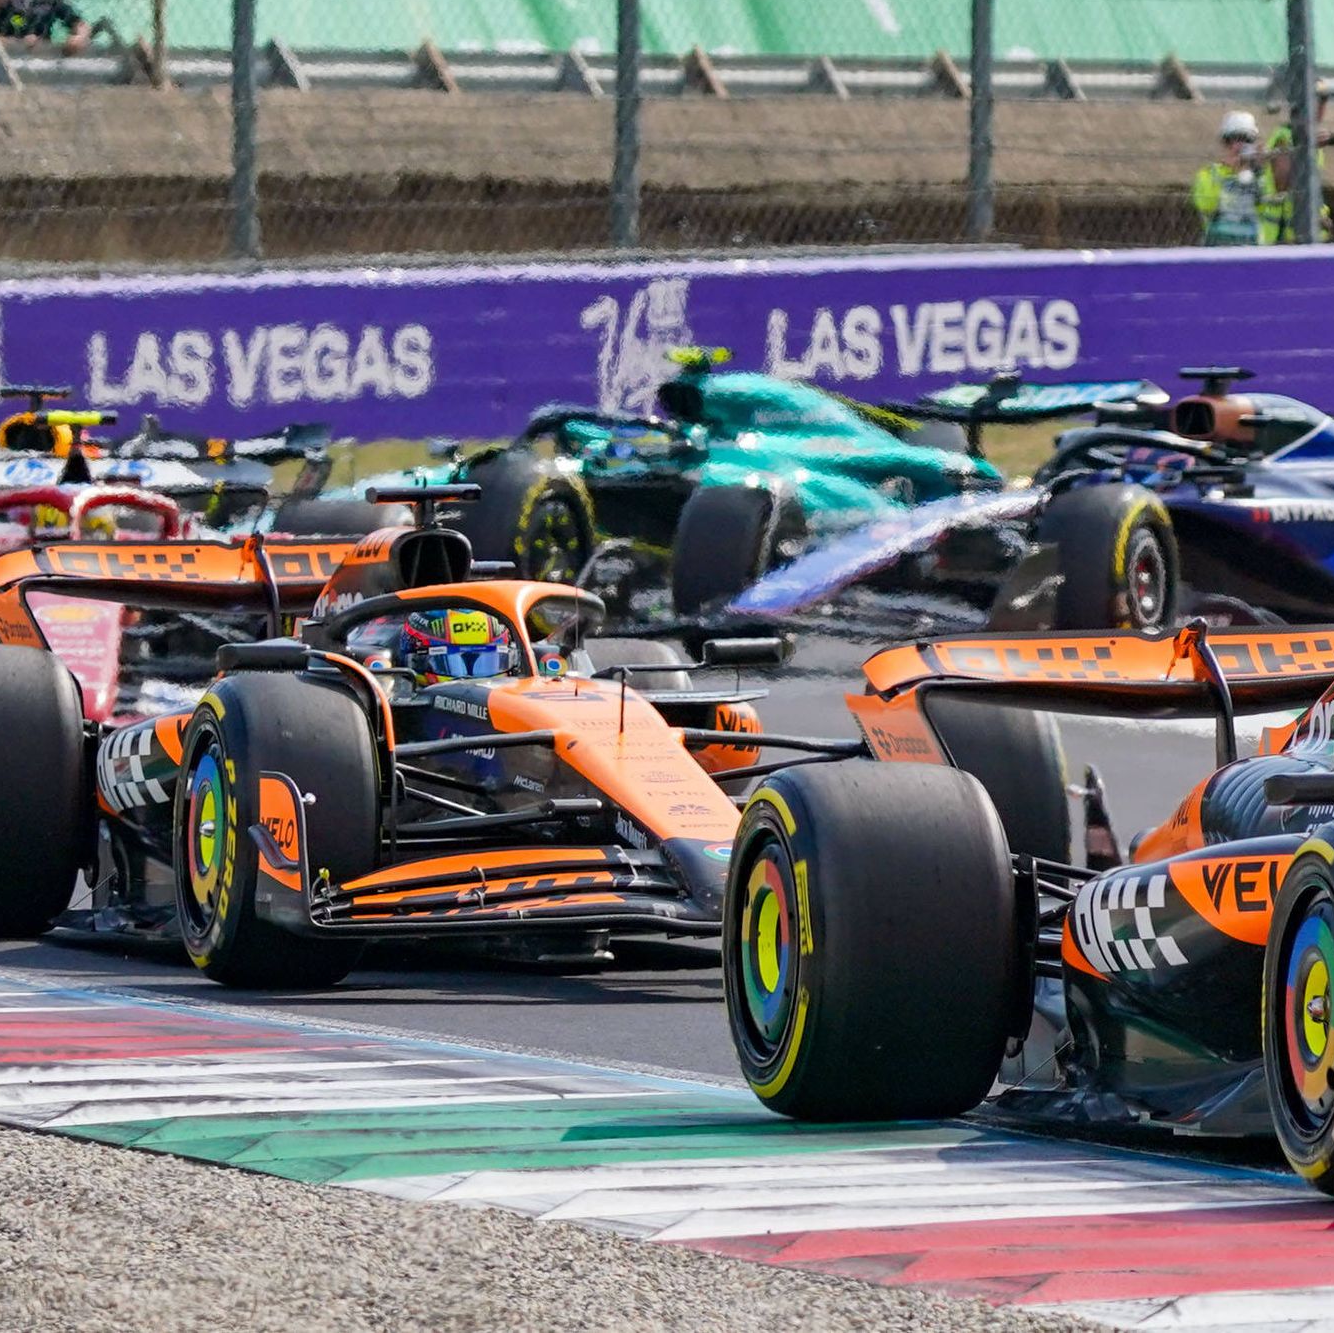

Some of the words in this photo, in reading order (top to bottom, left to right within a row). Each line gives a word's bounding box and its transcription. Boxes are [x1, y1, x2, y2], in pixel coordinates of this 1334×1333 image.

[85, 330, 215, 409] LAS
[222, 322, 434, 408] VEGAS
[766, 305, 883, 381] LAS
[890, 299, 1080, 377] VEGAS
[434, 695, 466, 715] RICHARD
[466, 702, 489, 720] MILLE
[225, 759, 236, 784] P
[514, 775, 546, 793] McLaren
[218, 796, 237, 921] ZERO
[1202, 861, 1285, 914] VEL
